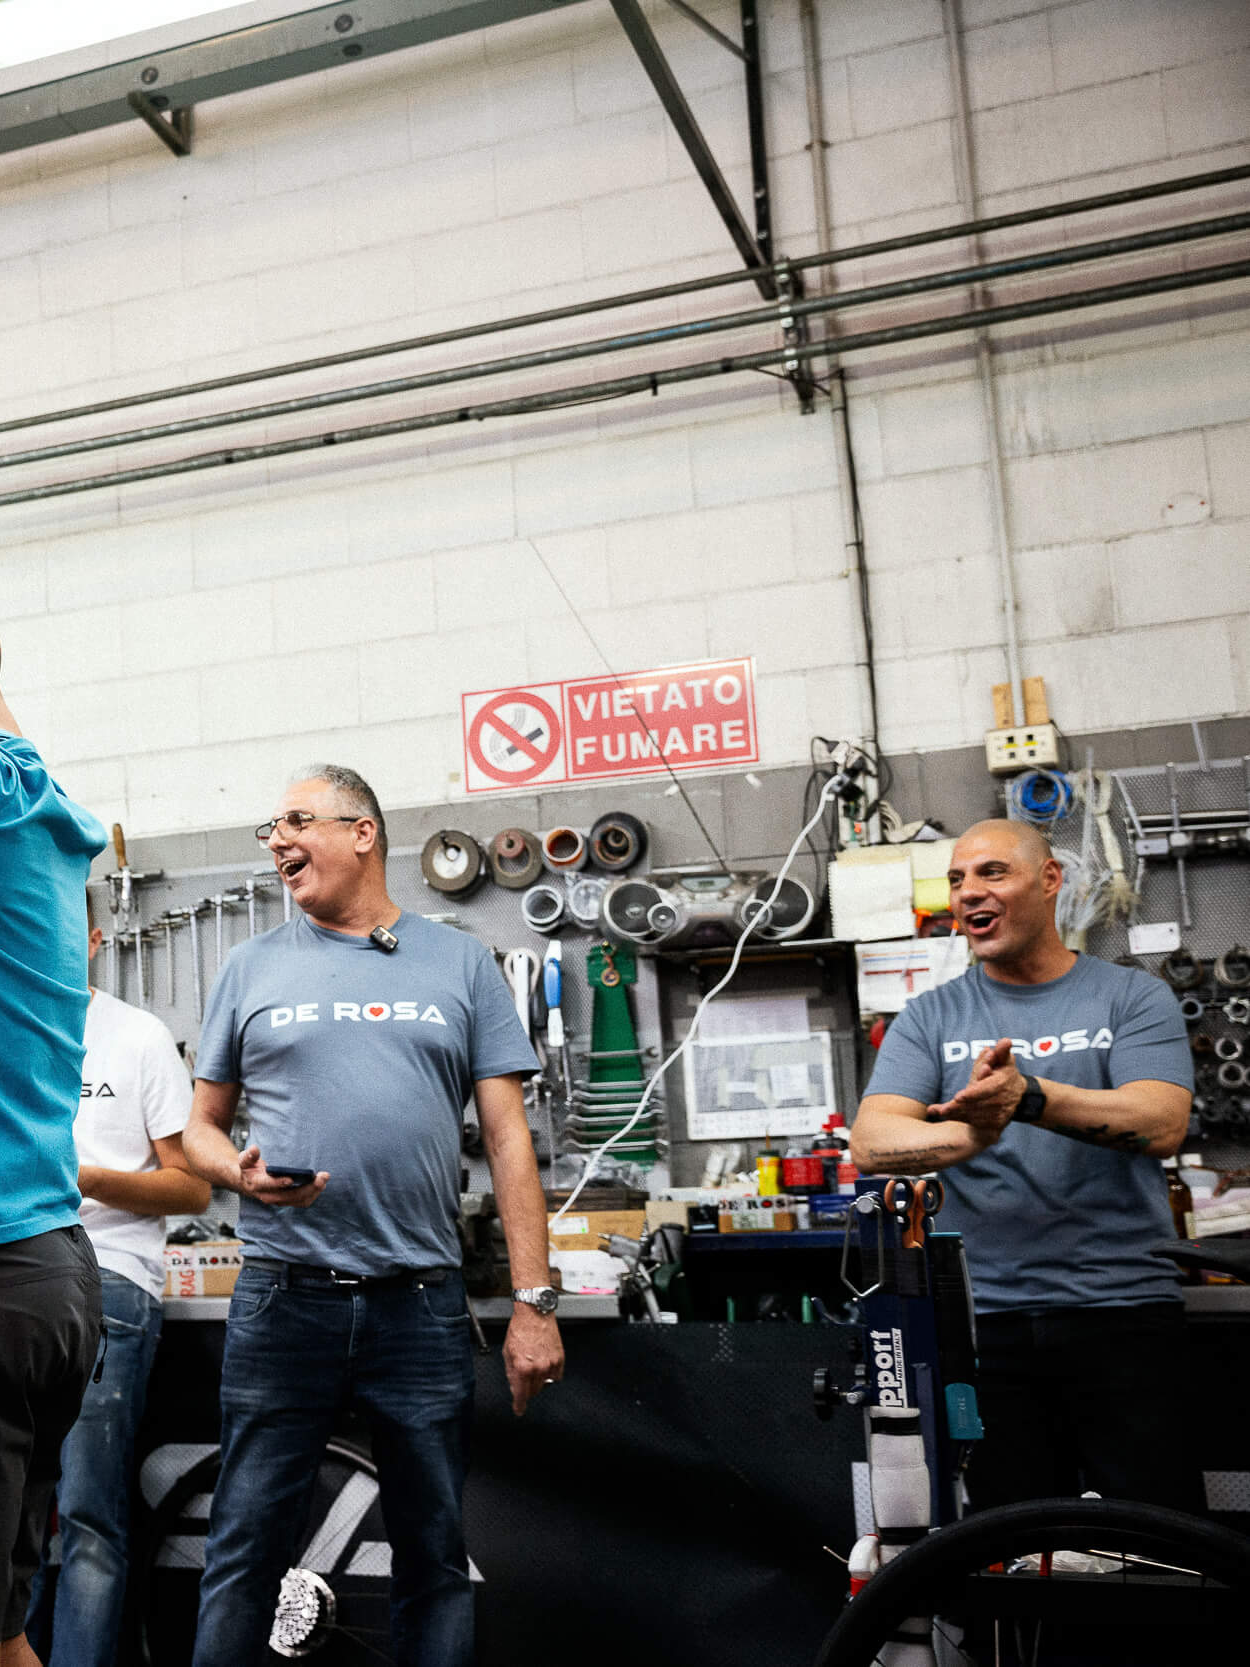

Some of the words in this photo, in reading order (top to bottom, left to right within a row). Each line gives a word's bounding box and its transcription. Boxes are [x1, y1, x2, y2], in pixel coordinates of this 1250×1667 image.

[574, 674, 742, 722] VIETATO
[576, 719, 746, 765] FUMARE
[270, 1002, 320, 1028] DE
[334, 1001, 448, 1026] ROSA
[1009, 1027, 1114, 1060] ROSA
[870, 1330, 903, 1408] pport
